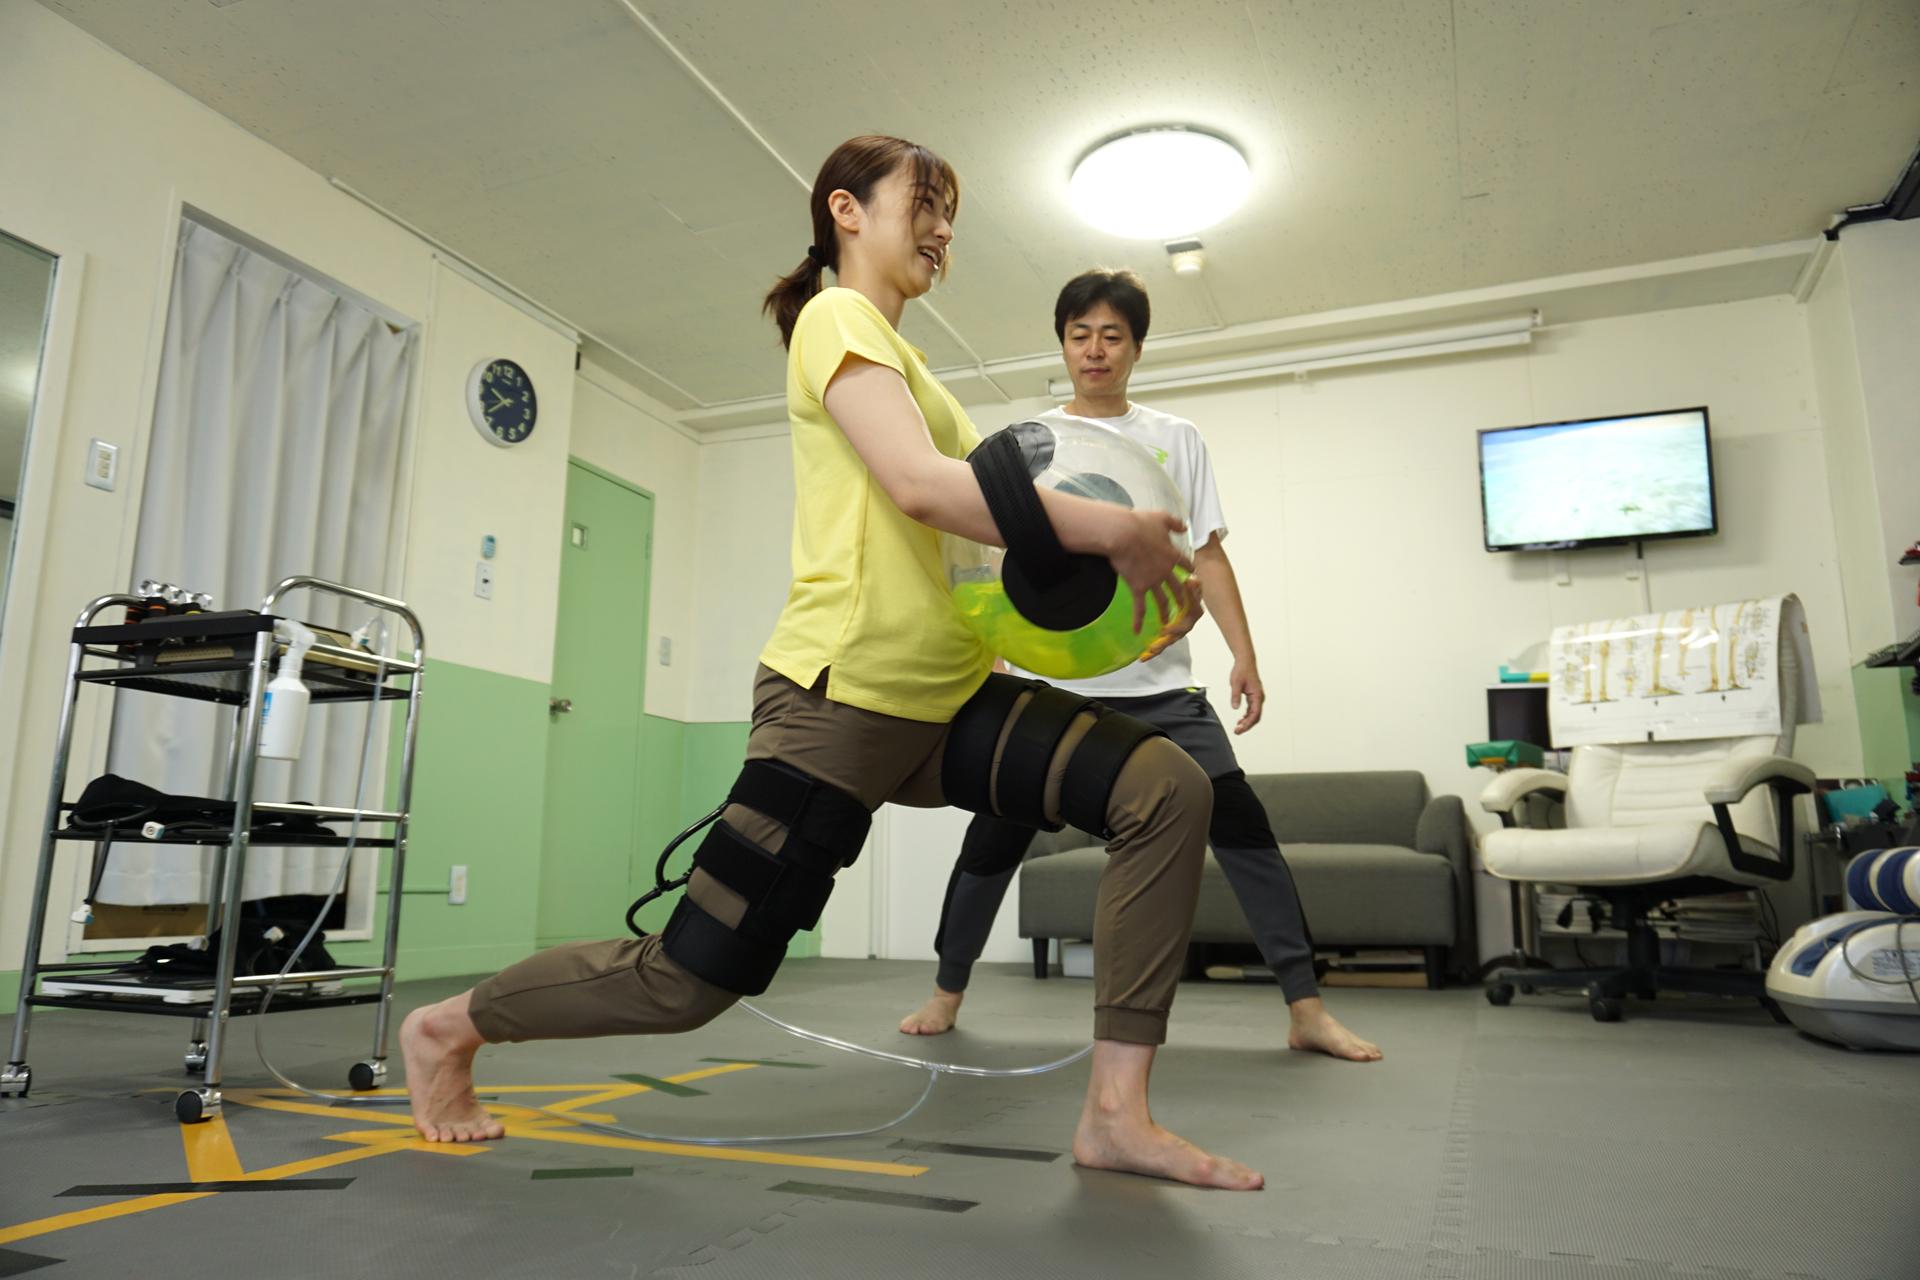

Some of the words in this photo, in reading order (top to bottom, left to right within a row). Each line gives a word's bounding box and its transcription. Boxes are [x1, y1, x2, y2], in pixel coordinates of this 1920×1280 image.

[503, 365, 514, 379] 12
[516, 376, 523, 387] 1
[521, 391, 529, 403] 2
[522, 408, 530, 420] 3
[508, 427, 517, 440] 5
[518, 422, 526, 433] 4
